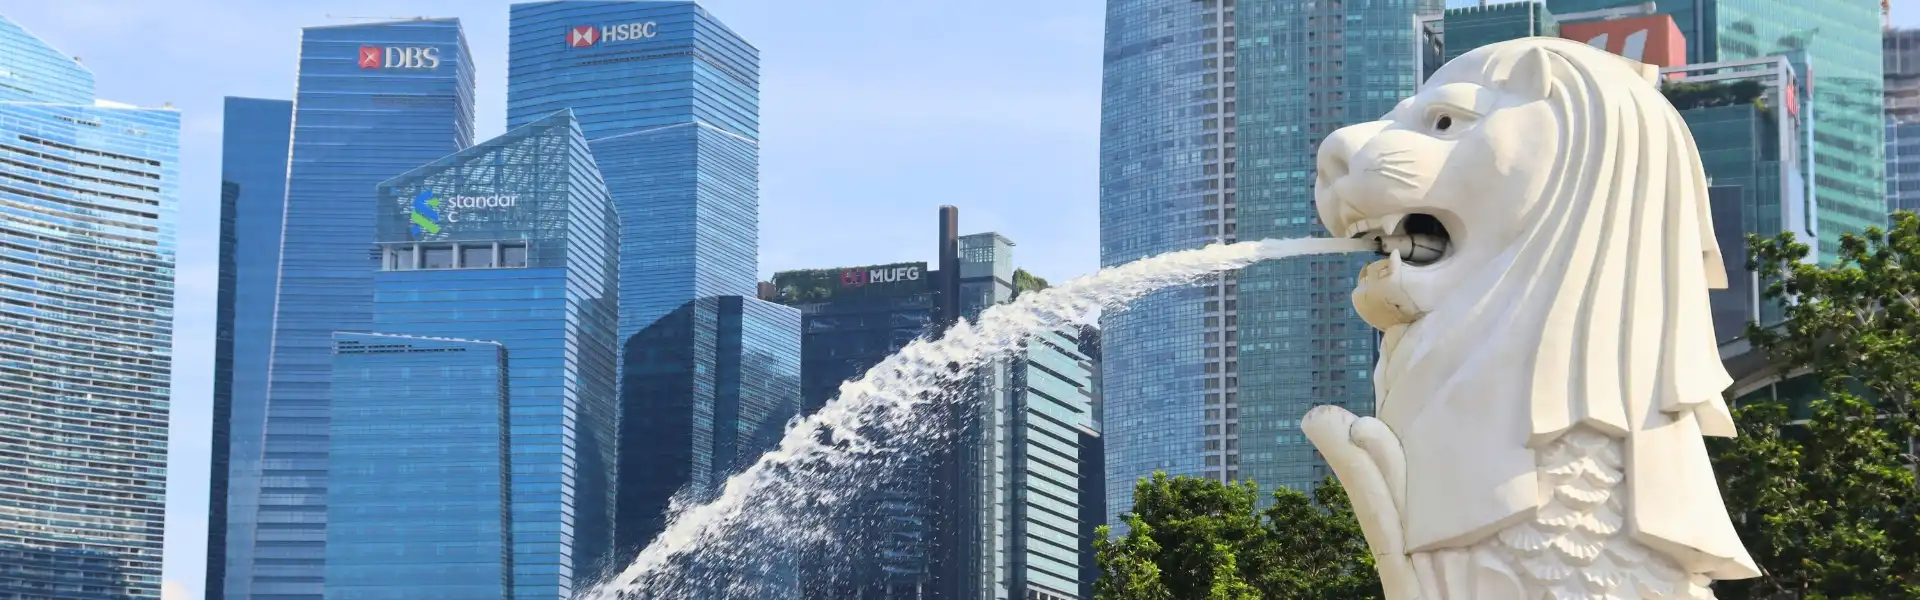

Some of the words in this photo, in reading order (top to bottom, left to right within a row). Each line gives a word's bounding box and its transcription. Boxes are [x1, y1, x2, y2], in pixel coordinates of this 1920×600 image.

[602, 21, 656, 42] HSBC
[384, 46, 439, 68] DBS
[870, 266, 919, 283] MUFG
